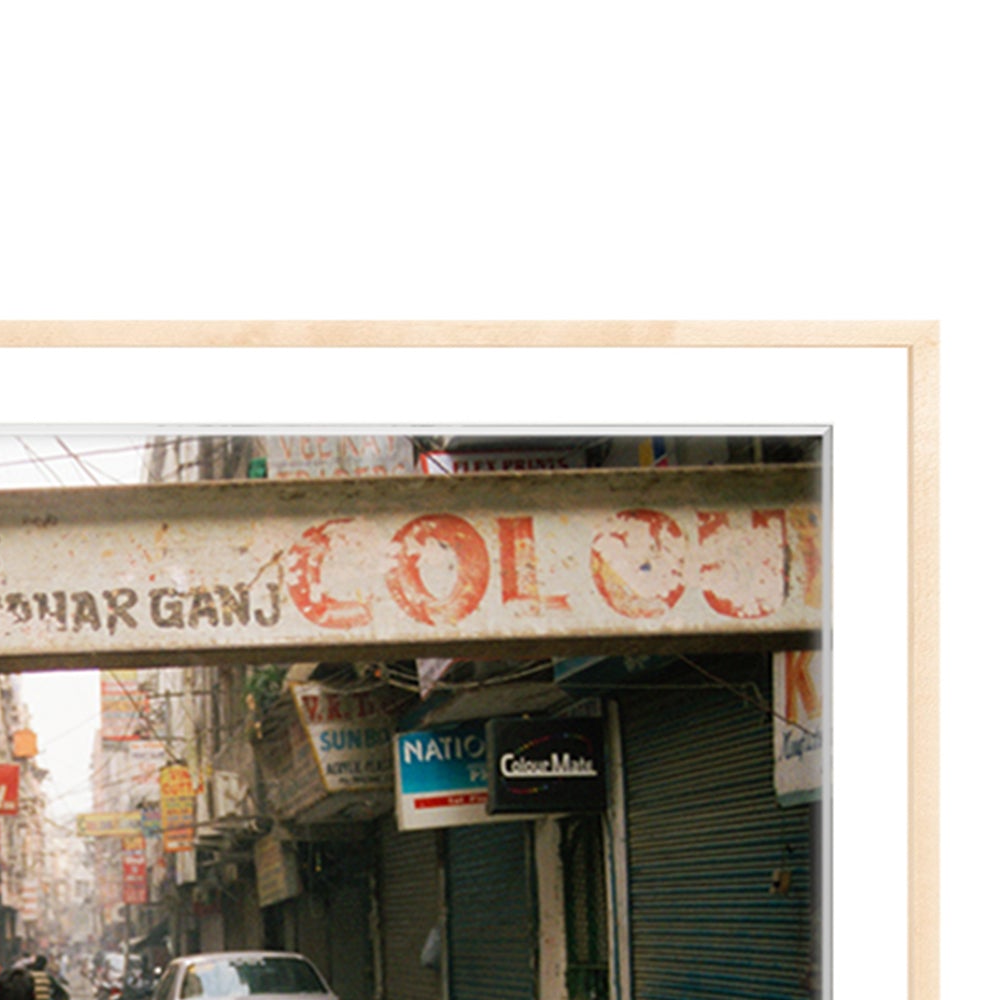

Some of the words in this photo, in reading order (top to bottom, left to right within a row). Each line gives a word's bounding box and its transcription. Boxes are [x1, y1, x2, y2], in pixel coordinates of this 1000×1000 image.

[148, 581, 283, 628] GANJ
[319, 729, 392, 752] SUNBO
[403, 735, 486, 763] NATIO
[501, 753, 549, 776] Colour
